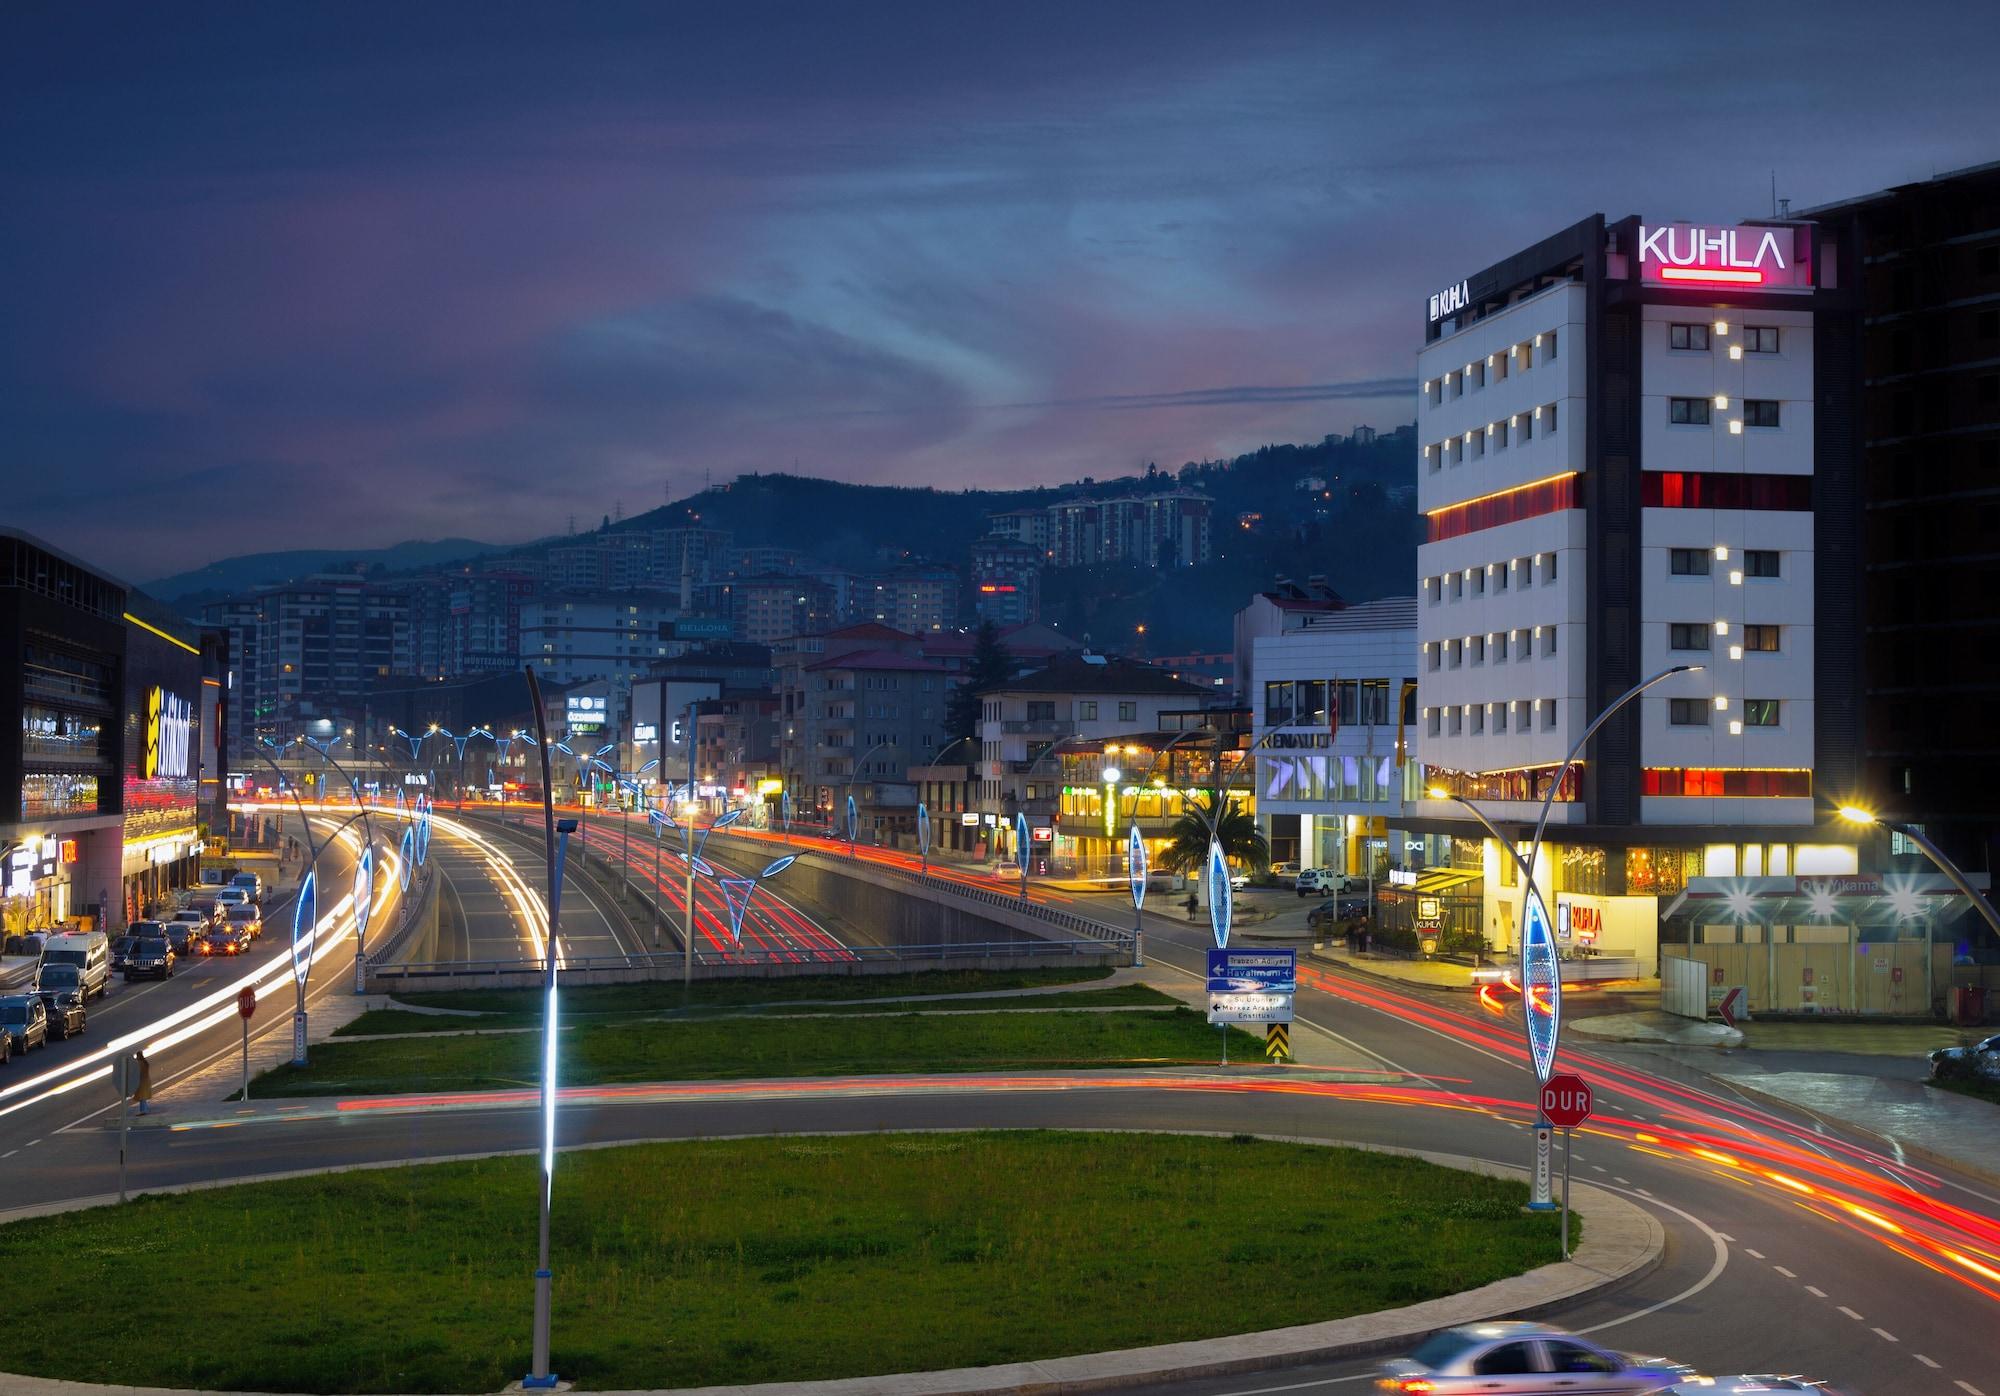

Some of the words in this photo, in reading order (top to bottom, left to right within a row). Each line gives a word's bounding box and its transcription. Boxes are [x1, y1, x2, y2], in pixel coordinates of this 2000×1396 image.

[1639, 225, 1785, 269] KUHLA
[1440, 279, 1469, 317] KUHLA
[680, 624, 728, 633] BELLONA
[1261, 733, 1329, 749] RENAULT
[1801, 879, 1825, 893] Oto
[1831, 879, 1878, 893] Yıkama
[1416, 921, 1442, 929] KUHLA
[1573, 906, 1602, 932] KUHLA
[1231, 957, 1259, 965] Trabzon
[1227, 968, 1281, 977] Havalimanı
[240, 995, 255, 1009] DUR
[1544, 1089, 1588, 1112] DUR
